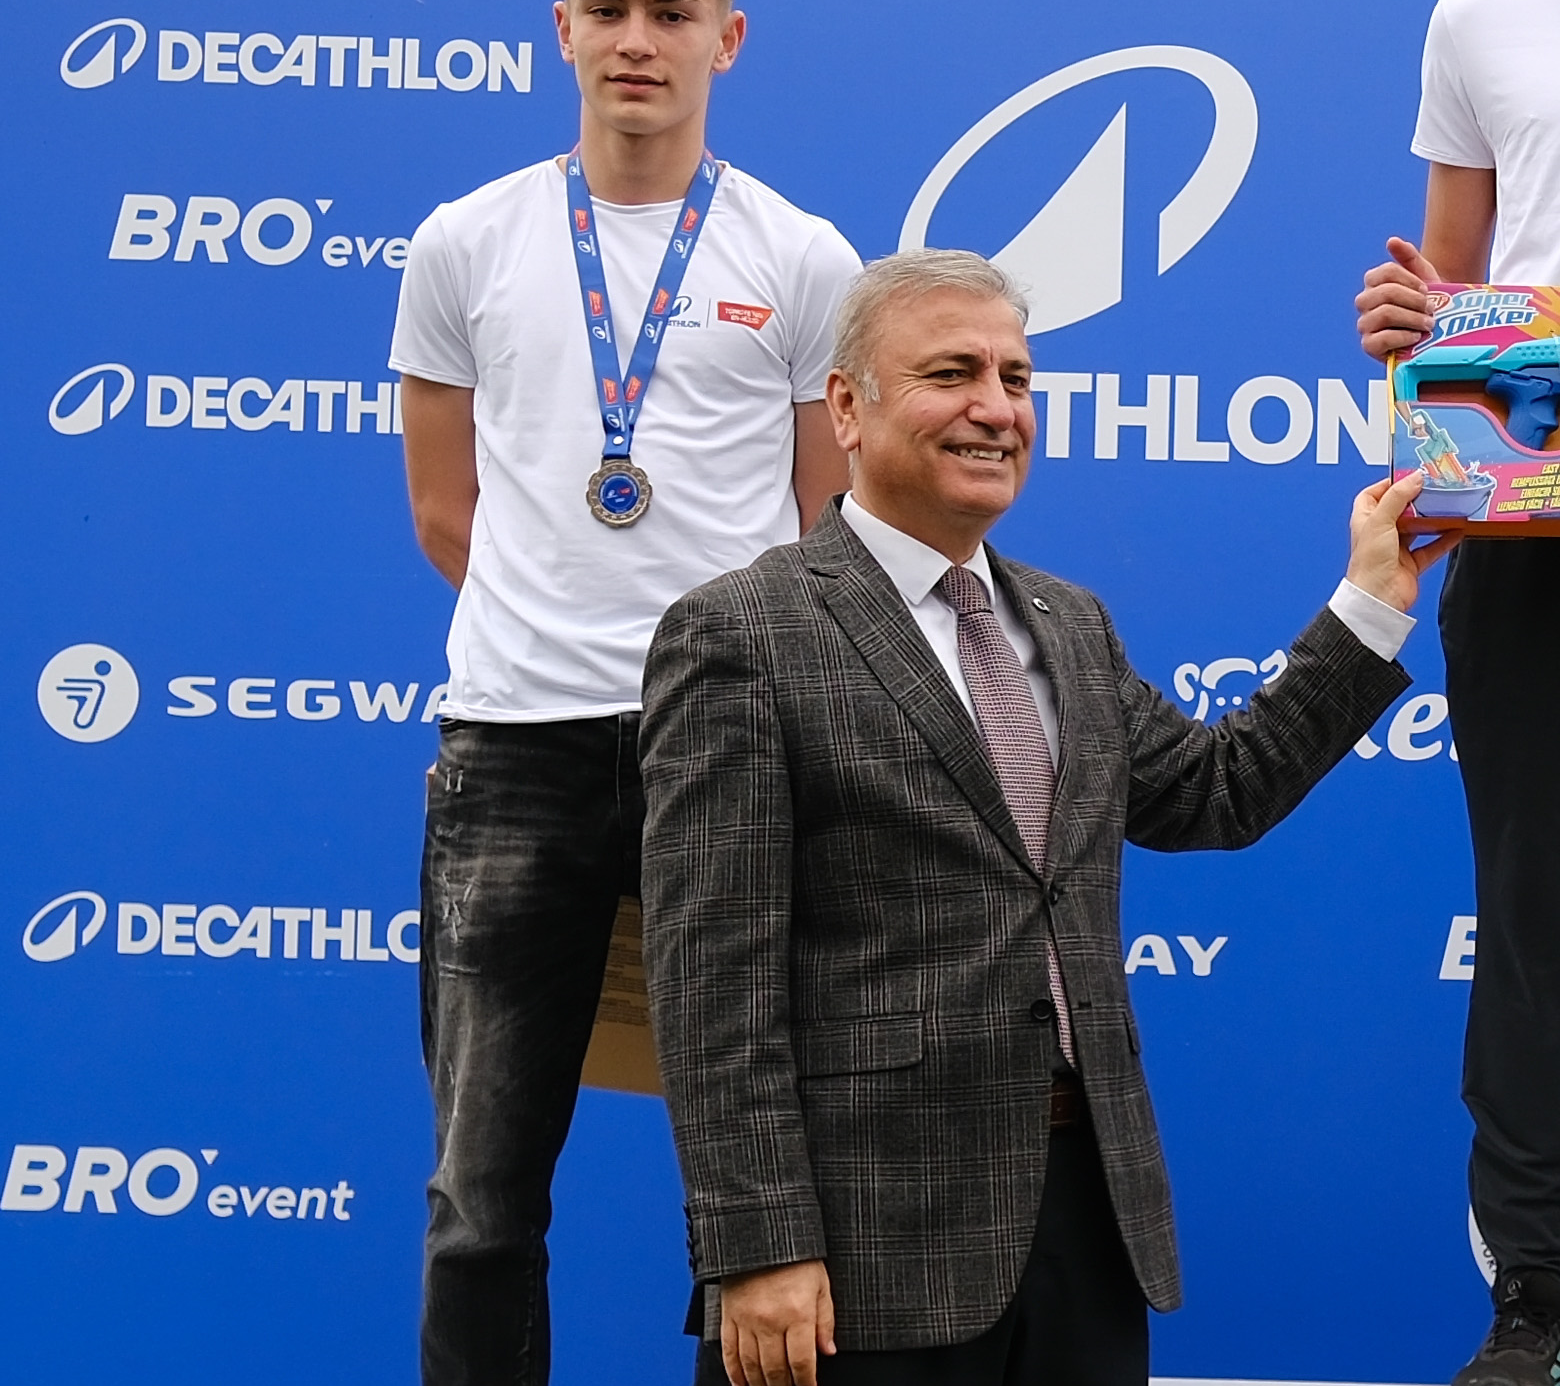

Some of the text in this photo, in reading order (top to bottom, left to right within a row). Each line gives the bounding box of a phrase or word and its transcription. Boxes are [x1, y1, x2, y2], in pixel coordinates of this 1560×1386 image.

[158, 29, 533, 93] DECATHLON
[108, 193, 411, 270] BRO eve
[1413, 308, 1538, 352] Soaker
[1440, 290, 1534, 313] Super
[145, 374, 404, 435] DECATH
[1030, 371, 1390, 467] THLON
[117, 902, 421, 963] DECATHLO
[0, 1144, 354, 1221] BRO event
